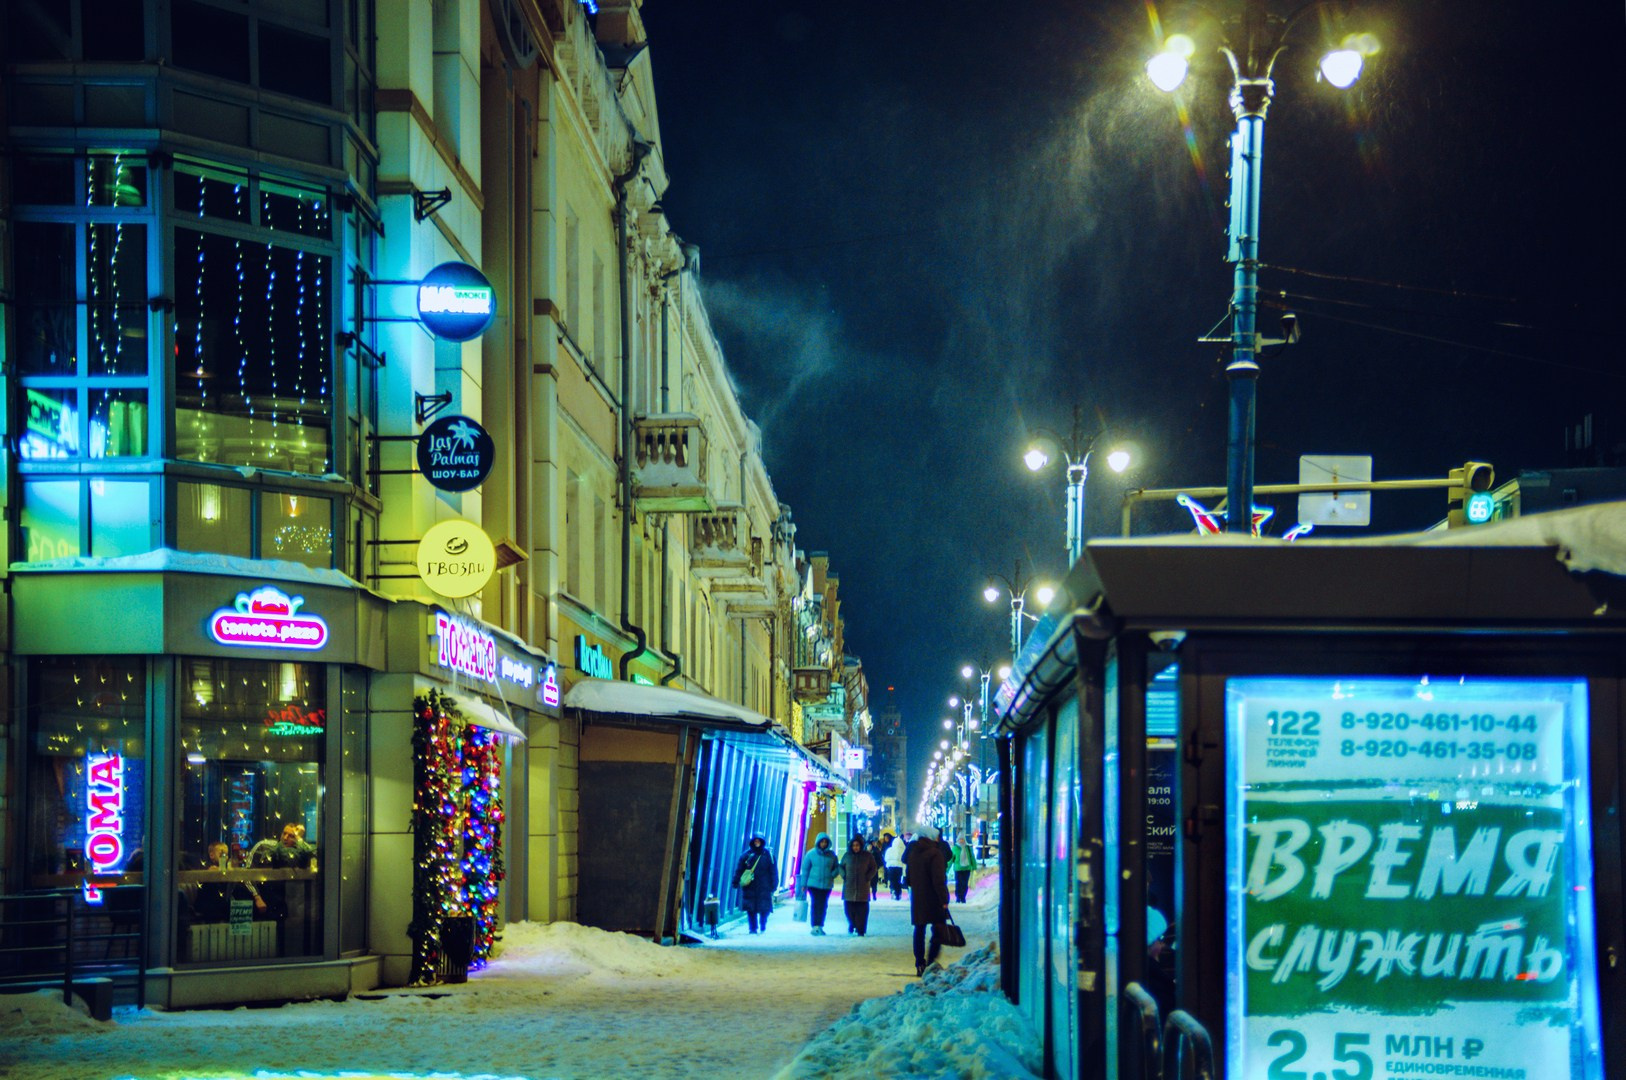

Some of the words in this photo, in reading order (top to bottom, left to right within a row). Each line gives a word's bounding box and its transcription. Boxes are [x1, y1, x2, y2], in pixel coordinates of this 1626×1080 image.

[431, 451, 479, 467] Palmas
[432, 470, 480, 479] ШОУ-БАР
[1267, 711, 1321, 736] 122
[1340, 711, 1538, 733] 8-920-461-10-44
[1267, 738, 1320, 747] ТЕЛЕФОН
[1340, 739, 1538, 761] 8-920-461-35-08
[1148, 797, 1171, 805] 19:00
[1244, 819, 1565, 901] ВРЕМЯ
[1385, 1034, 1454, 1058] МЛН
[1386, 1061, 1526, 1080] ЕДИНОВРЕМЕННАЯ
